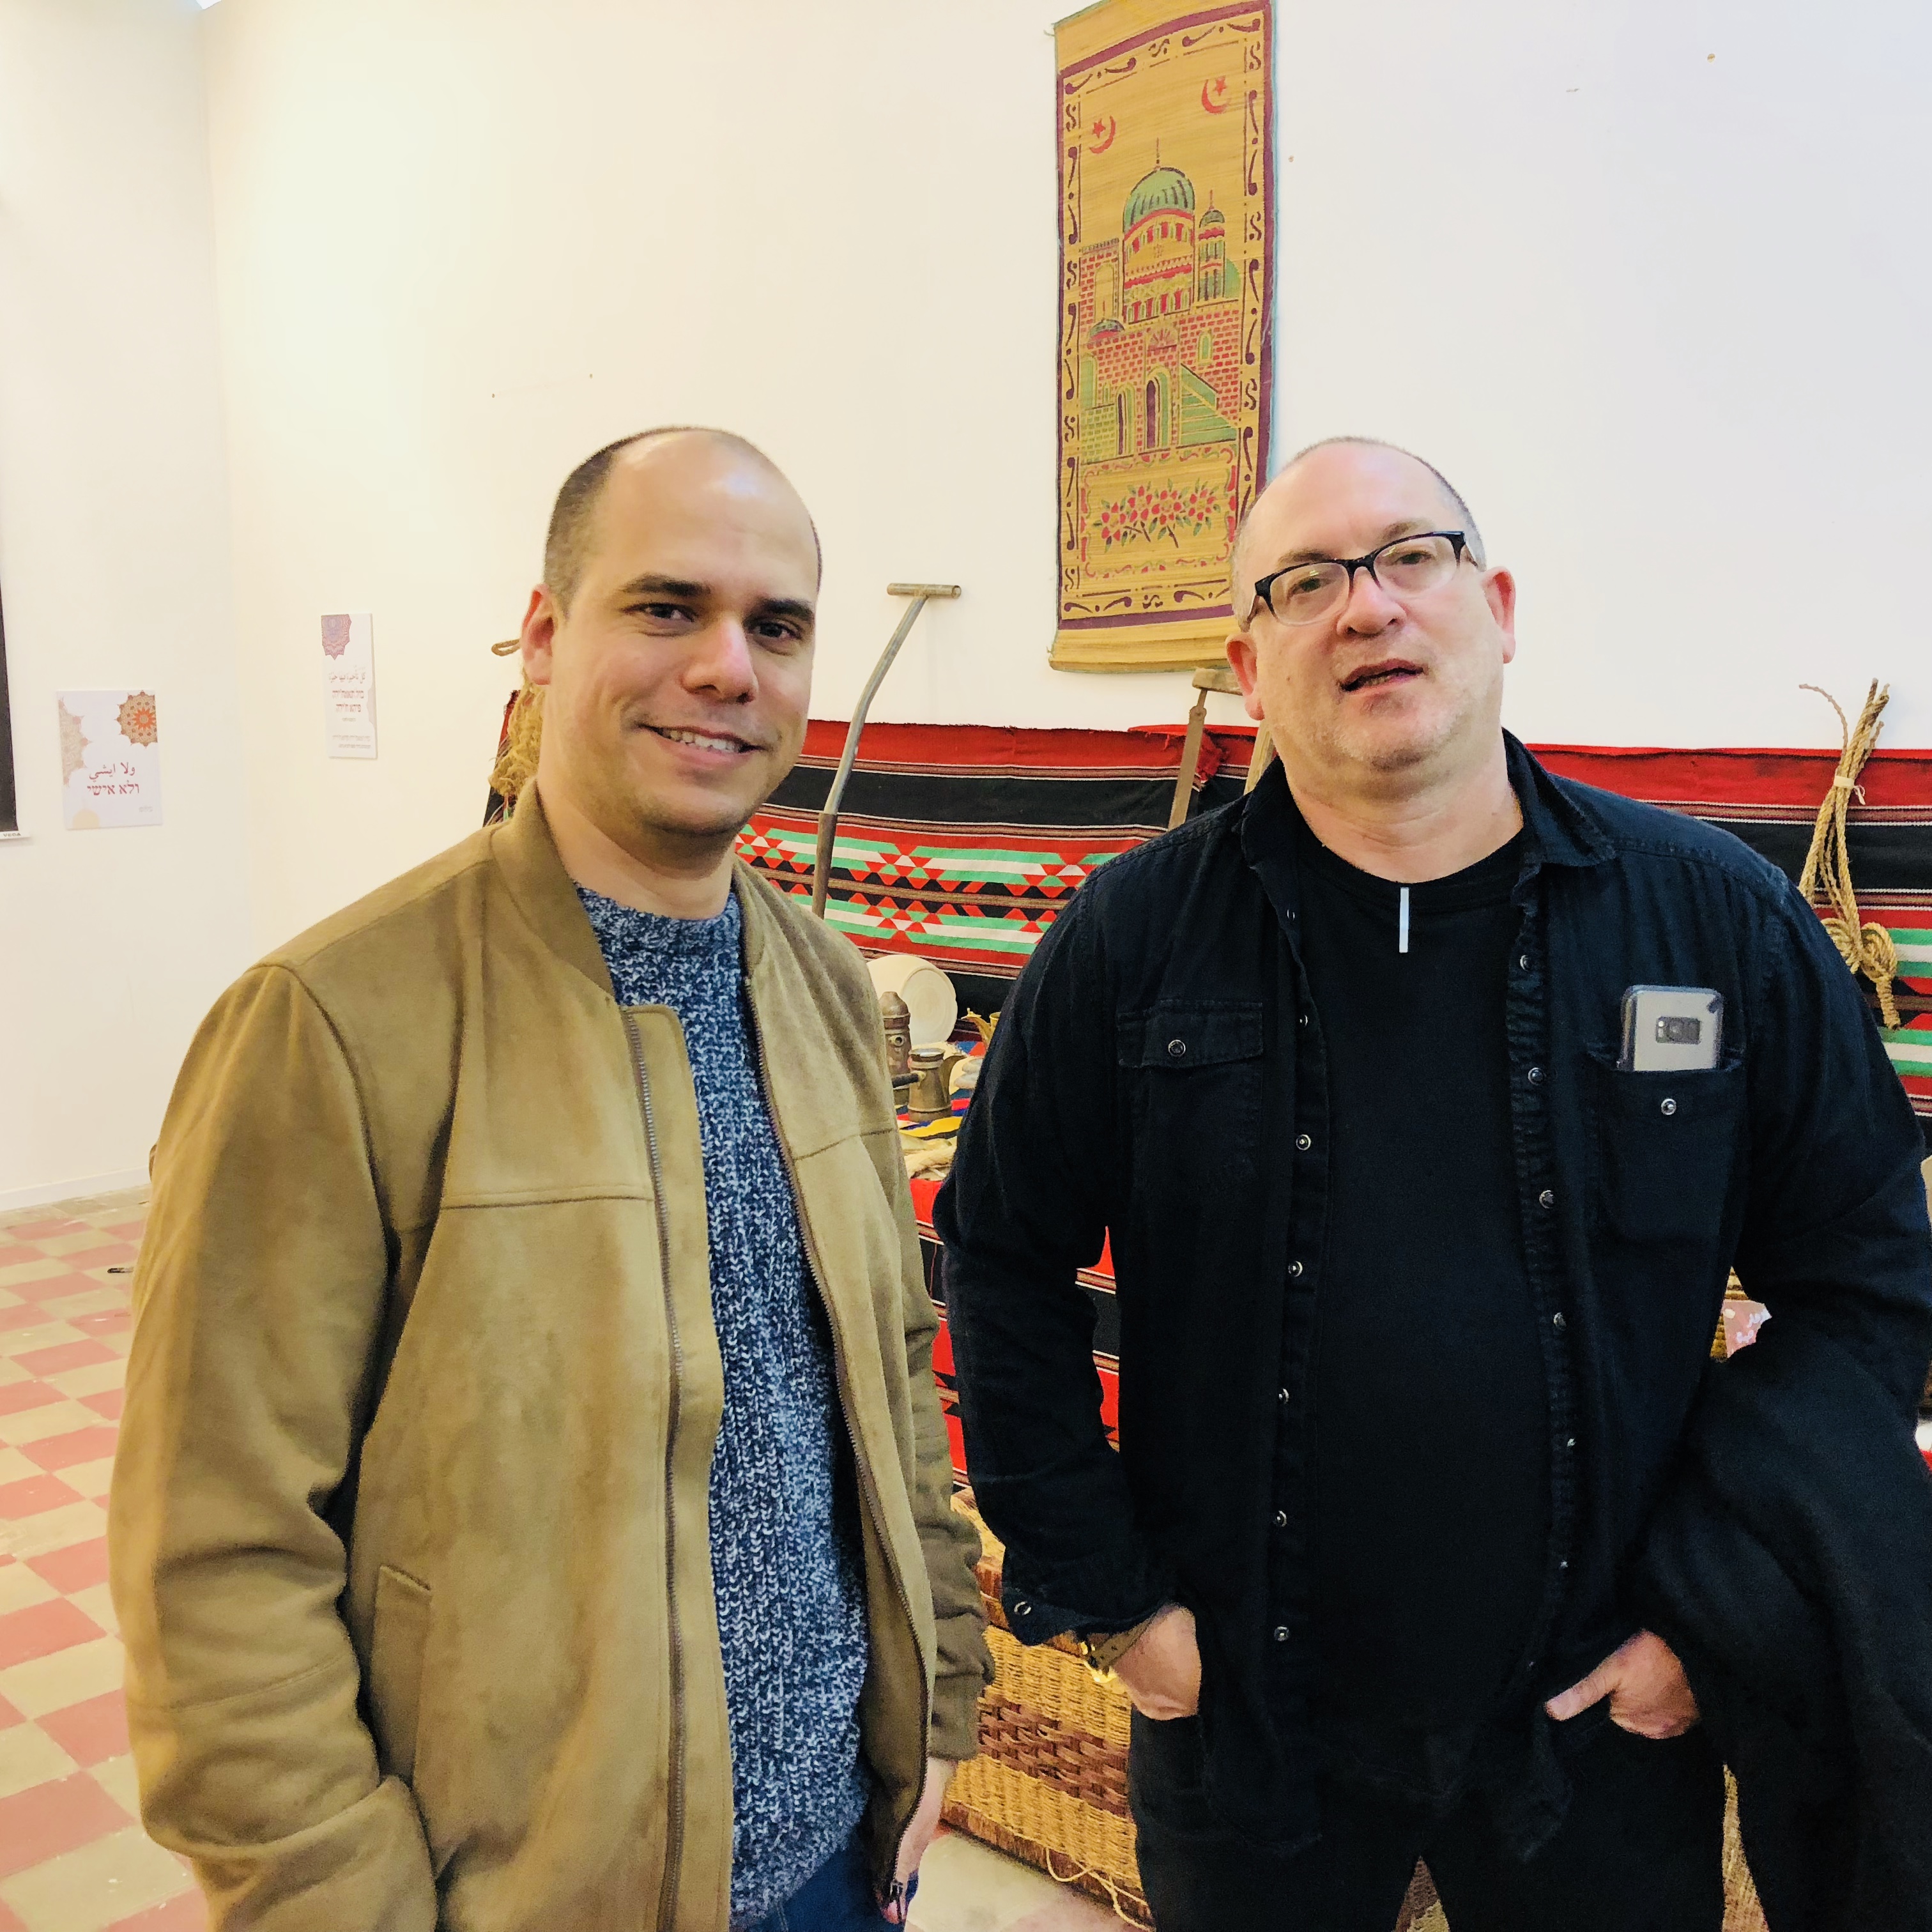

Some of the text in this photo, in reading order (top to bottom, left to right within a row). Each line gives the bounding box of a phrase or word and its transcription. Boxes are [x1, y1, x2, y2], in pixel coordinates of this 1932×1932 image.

[89, 762, 135, 783] ولا ايشي
[87, 779, 139, 795] ולא אישי
